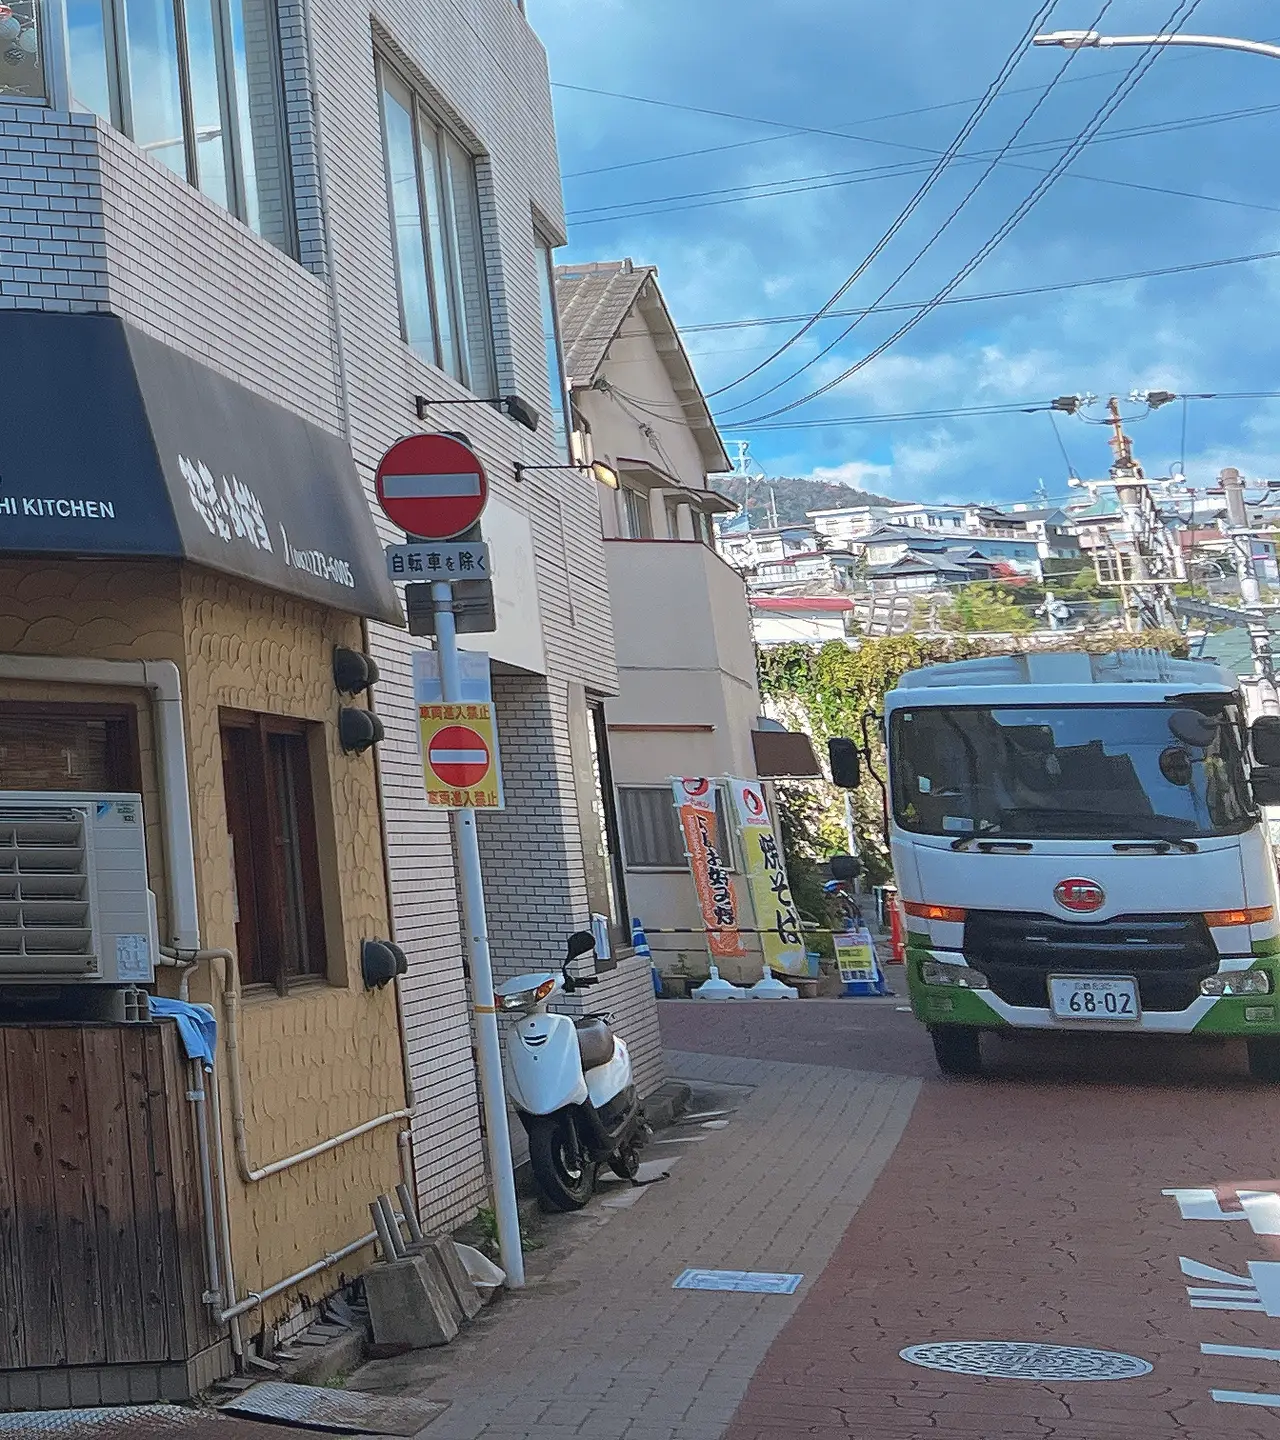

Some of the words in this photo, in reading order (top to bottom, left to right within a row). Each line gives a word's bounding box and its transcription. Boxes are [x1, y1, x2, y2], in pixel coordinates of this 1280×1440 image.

[22, 495, 114, 519] KITCHEN
[391, 552, 486, 574] 自転車を除く
[419, 703, 490, 720] 車両進入禁止
[427, 790, 497, 808] 車両進入禁止
[1069, 991, 1134, 1014] 68-02
